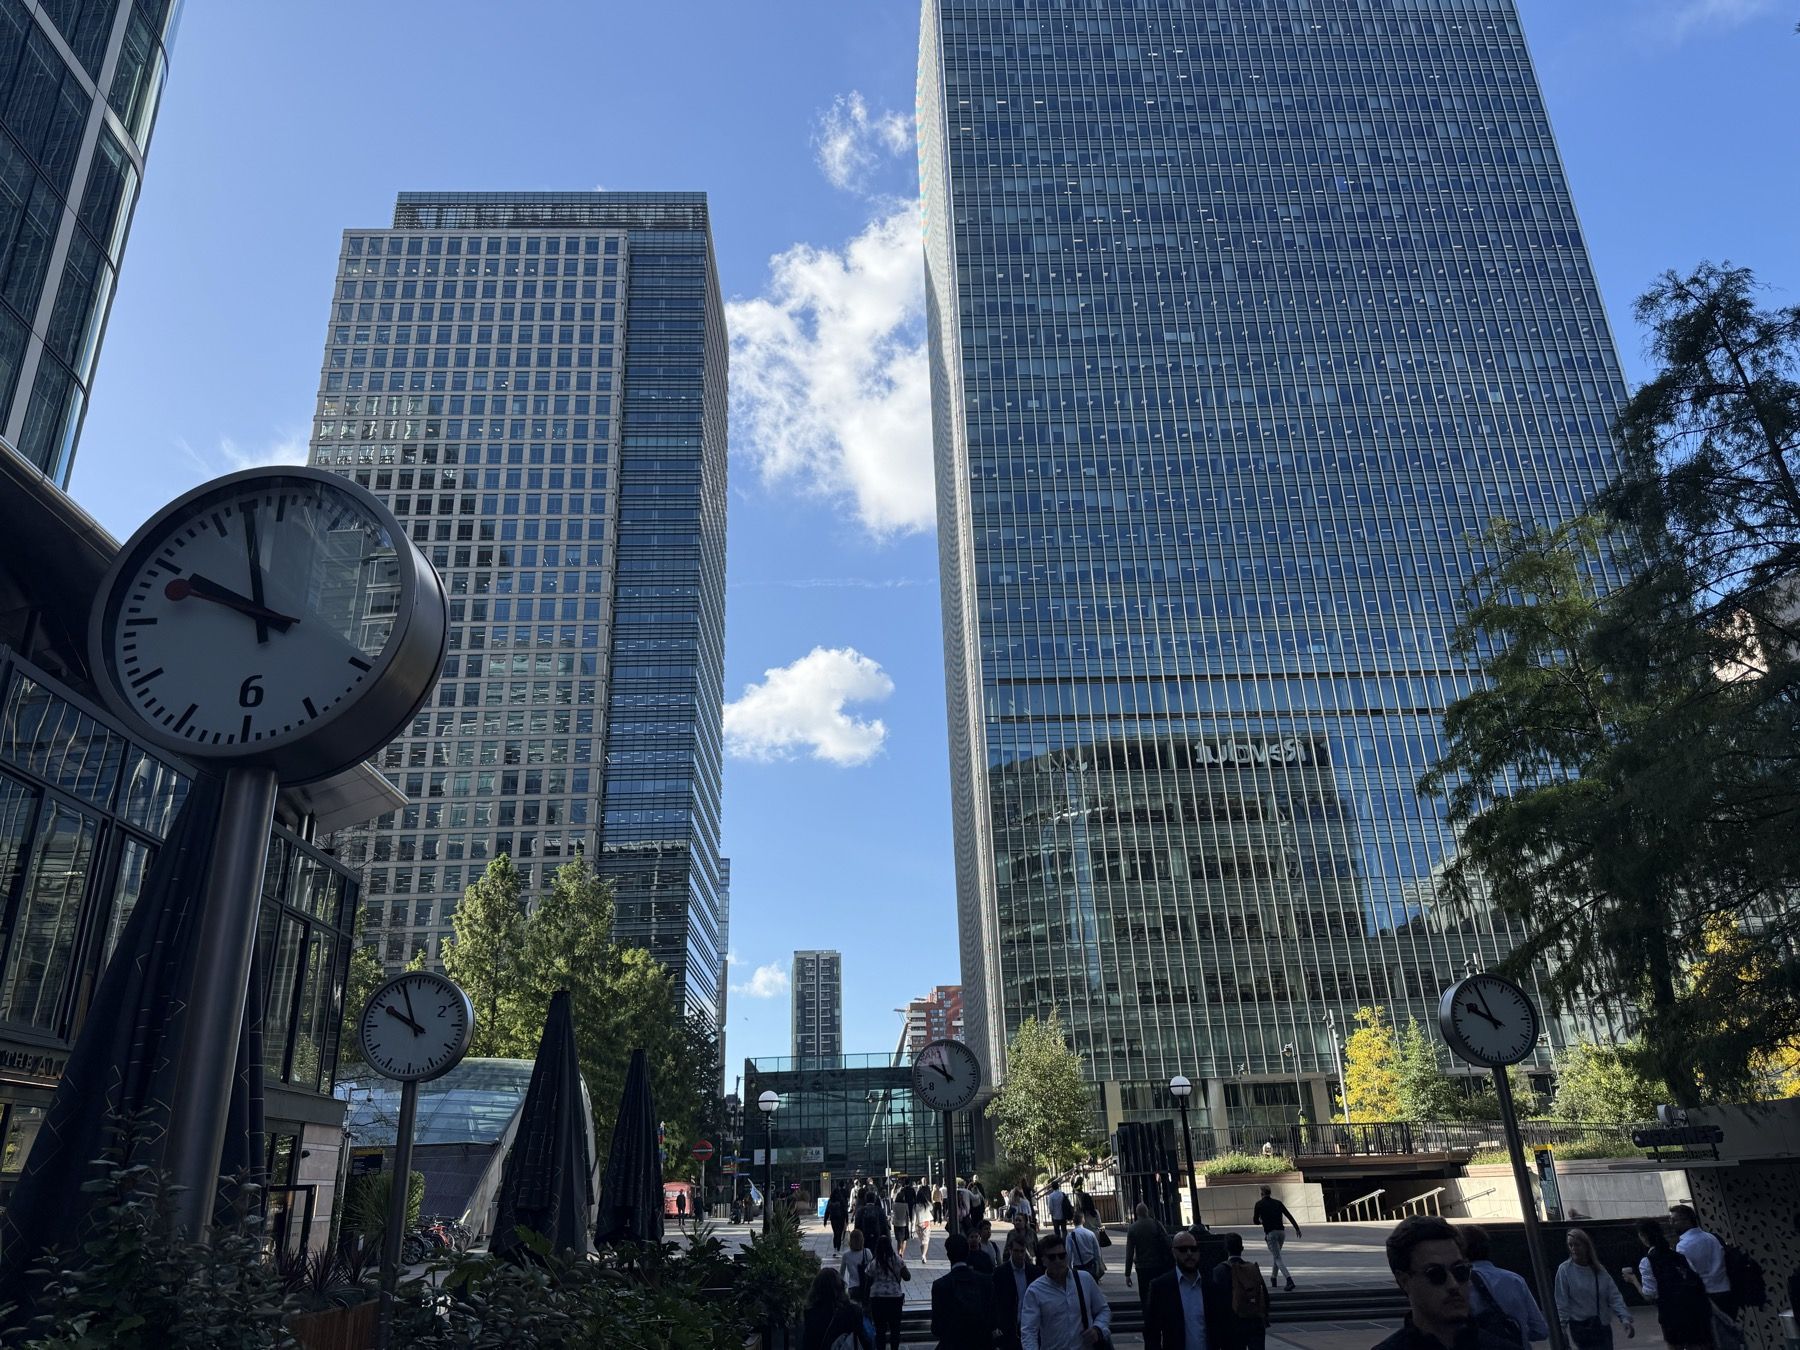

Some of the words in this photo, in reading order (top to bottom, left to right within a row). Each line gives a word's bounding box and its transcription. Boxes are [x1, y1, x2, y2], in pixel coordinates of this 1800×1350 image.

[239, 675, 264, 707] 6
[436, 1005, 447, 1018] 2
[5, 1051, 33, 1069] THE
[928, 1081, 935, 1091] 8
